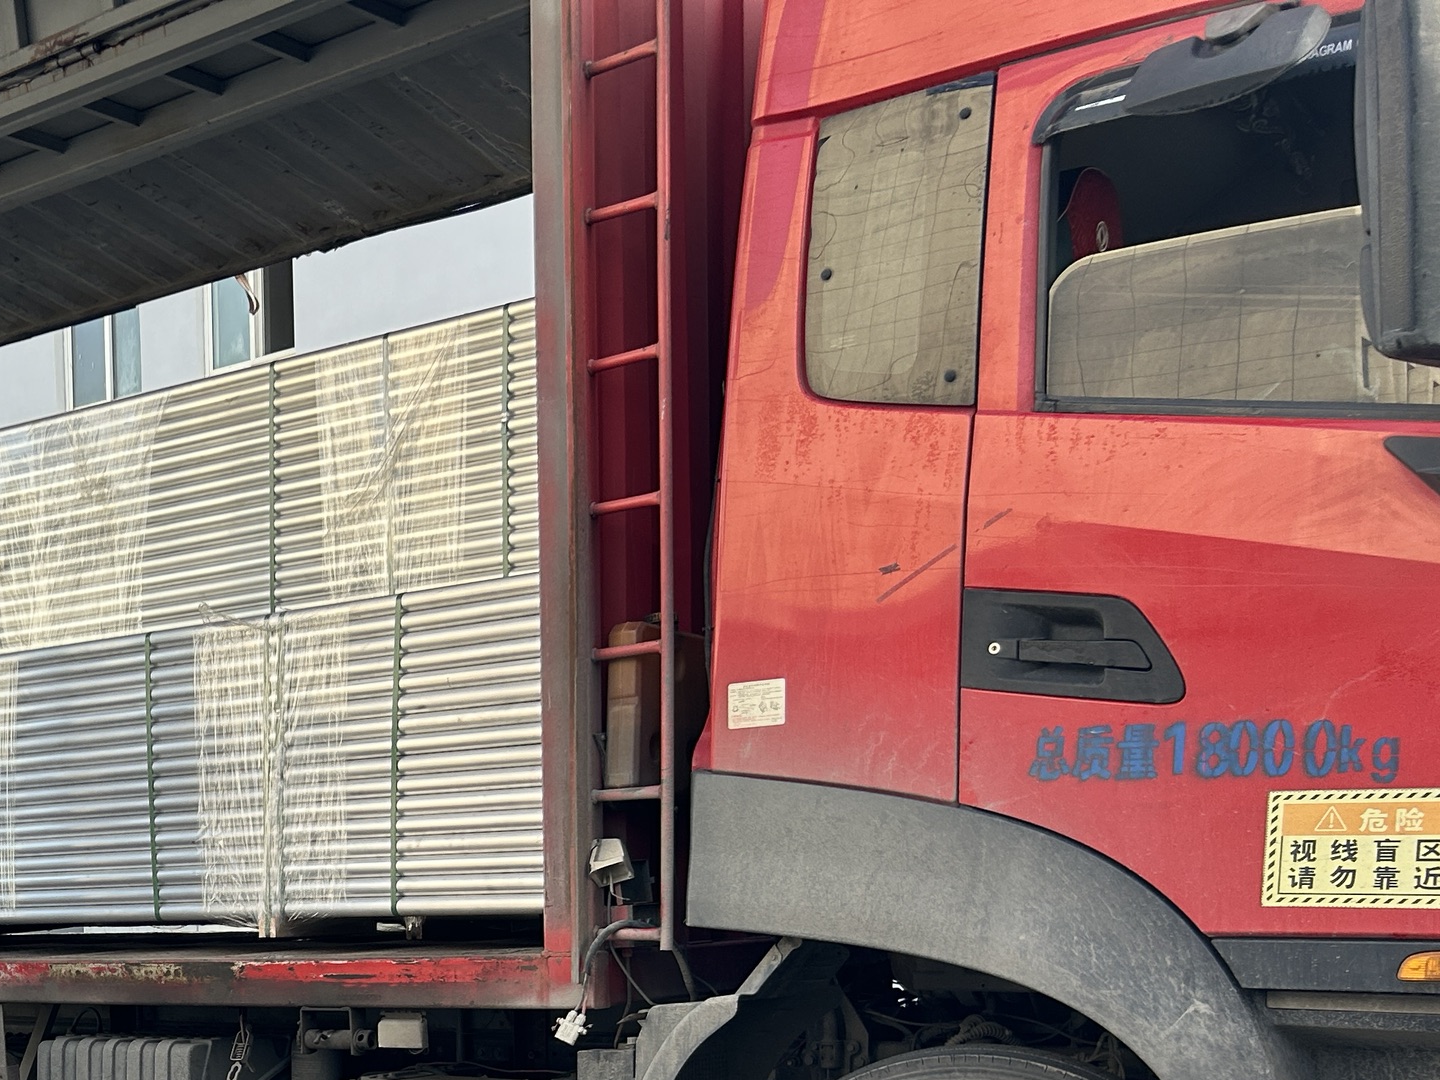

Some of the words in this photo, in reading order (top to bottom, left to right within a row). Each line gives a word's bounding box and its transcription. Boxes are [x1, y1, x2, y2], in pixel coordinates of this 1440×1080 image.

[1307, 39, 1353, 60] AGRAM
[1358, 806, 1425, 833] 危险
[1289, 838, 1440, 863] 视线盲区
[1288, 865, 1440, 891] 请勿靠近
